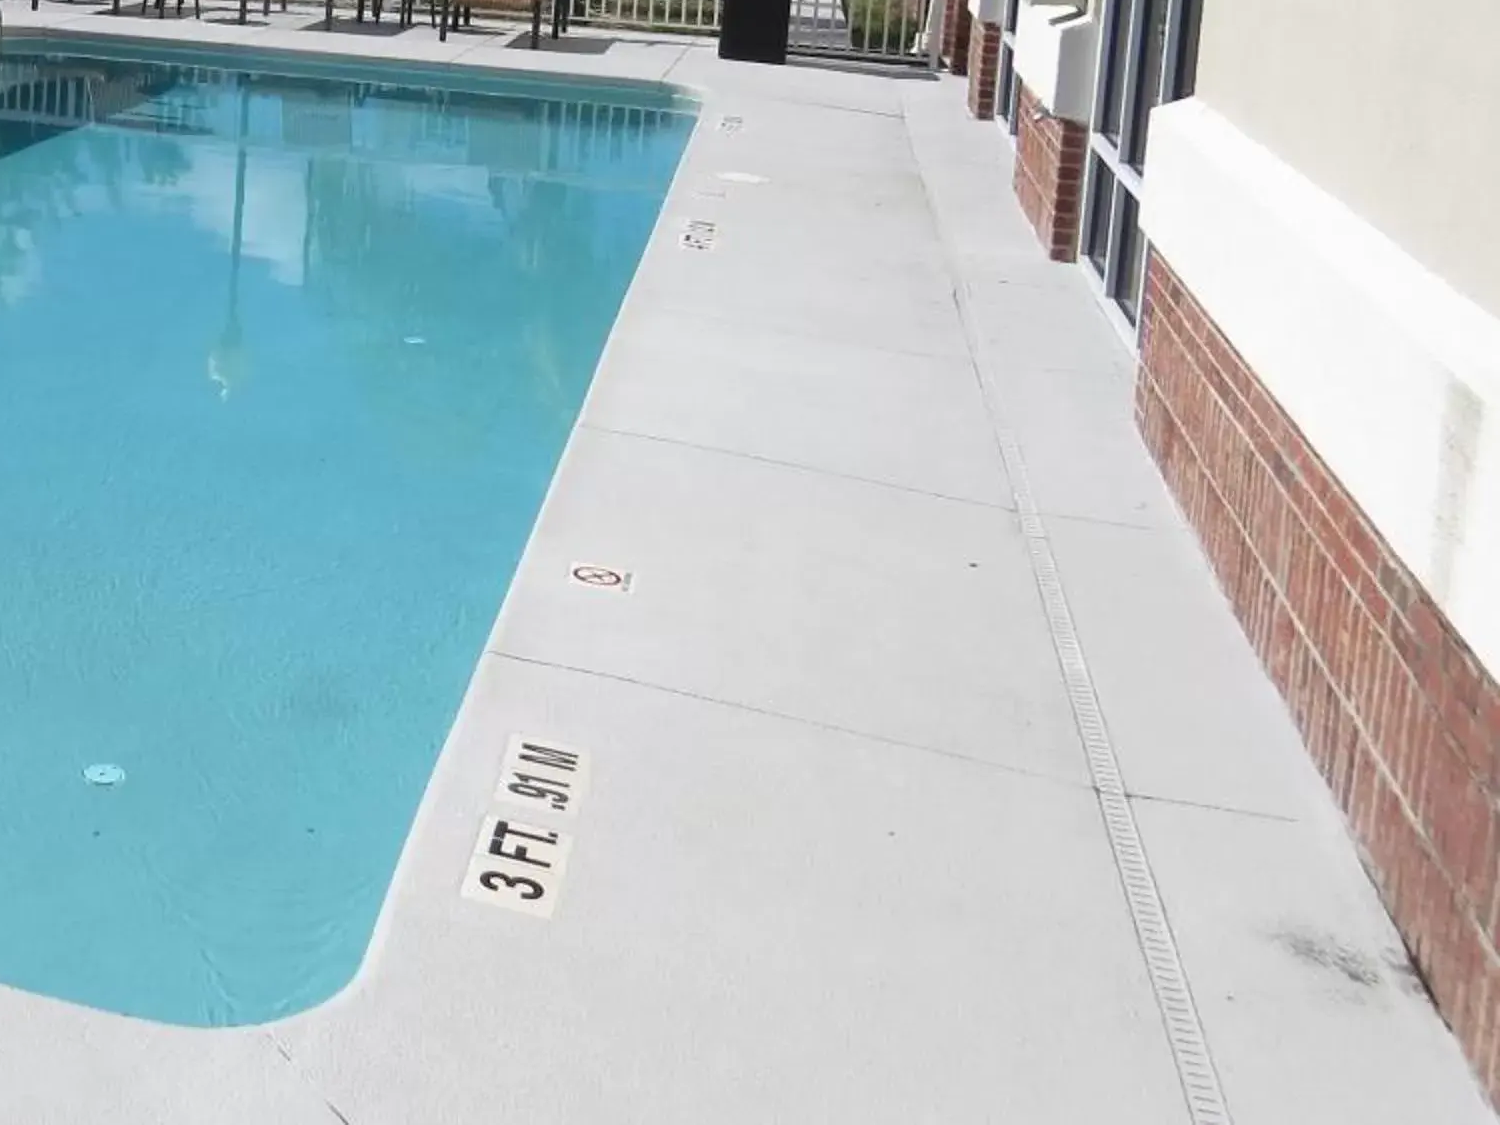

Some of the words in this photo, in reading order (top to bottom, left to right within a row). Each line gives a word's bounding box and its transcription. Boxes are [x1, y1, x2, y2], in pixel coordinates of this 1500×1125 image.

[518, 742, 579, 772] M
[507, 772, 571, 811] .91
[488, 820, 559, 868] FT.
[479, 870, 545, 900] 3
